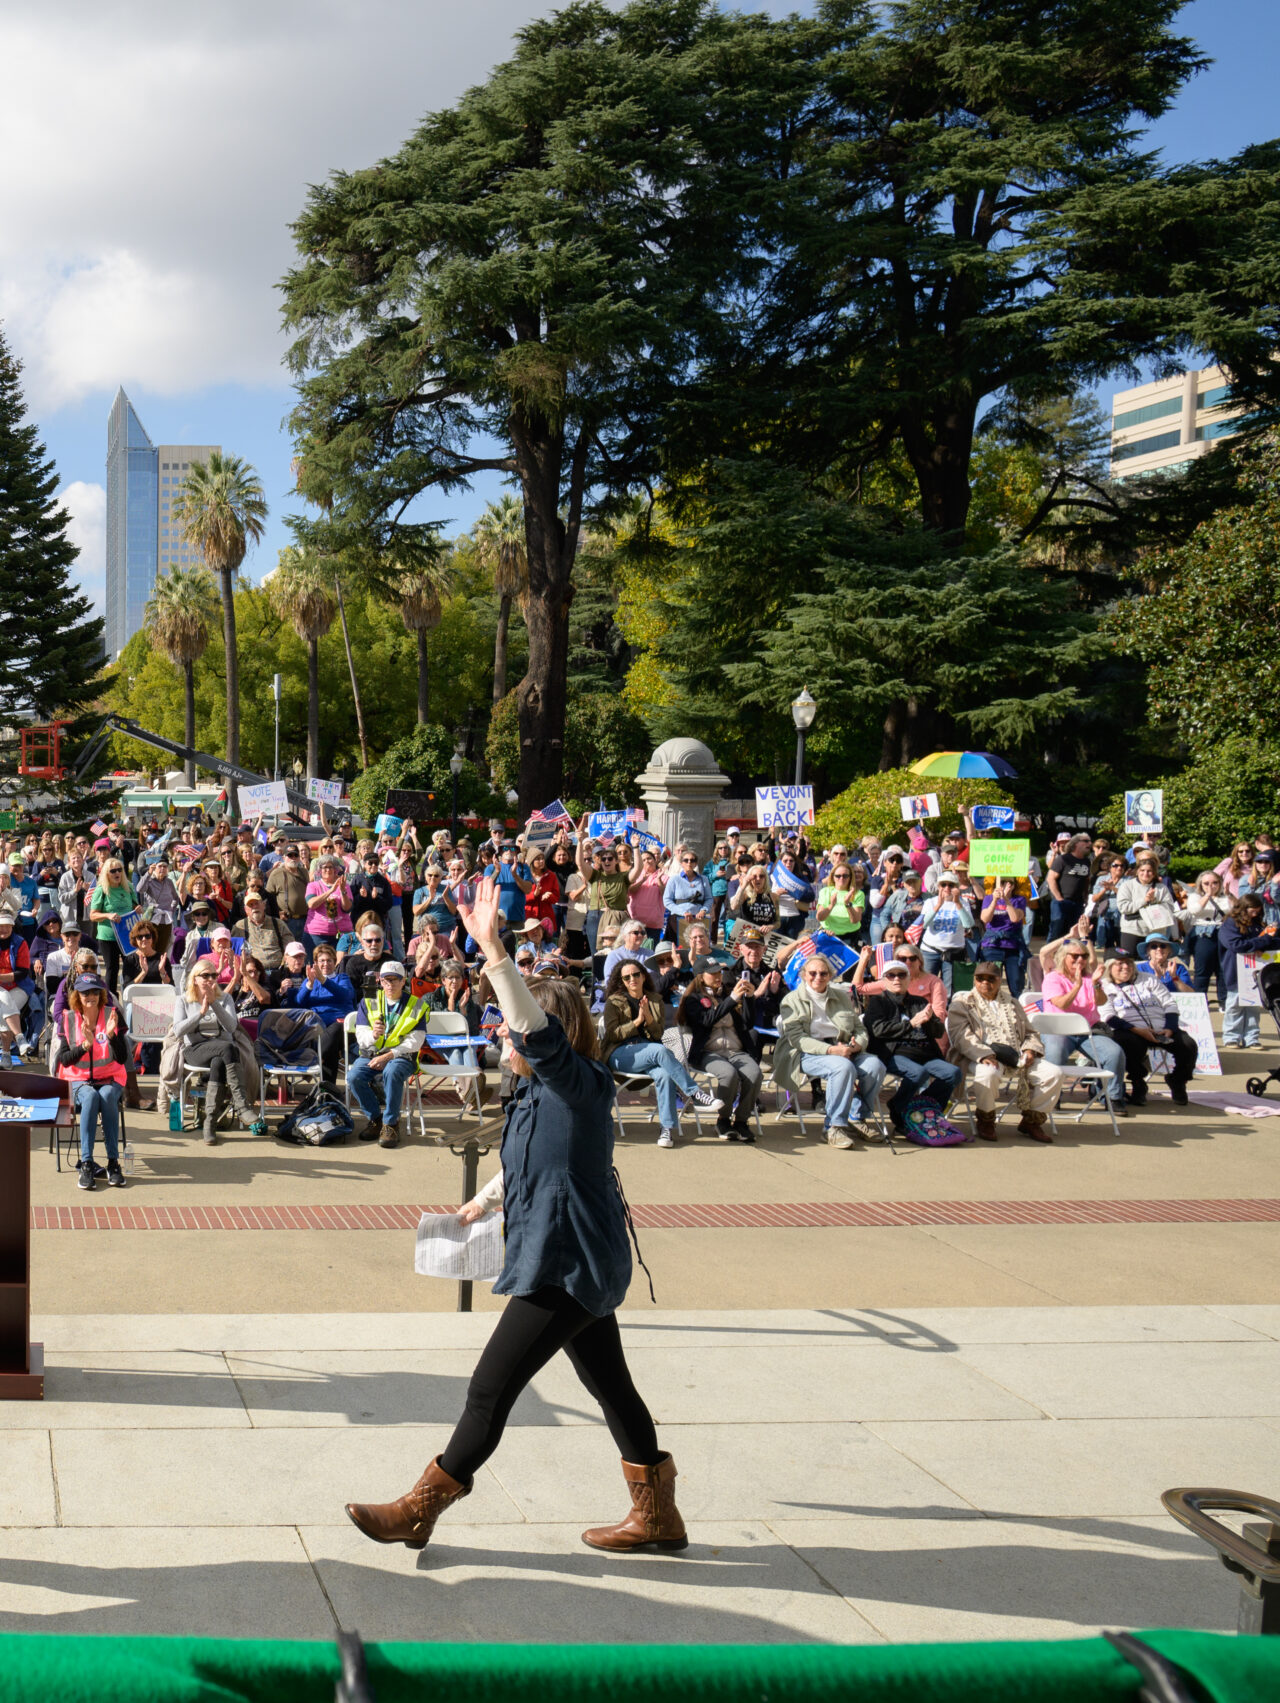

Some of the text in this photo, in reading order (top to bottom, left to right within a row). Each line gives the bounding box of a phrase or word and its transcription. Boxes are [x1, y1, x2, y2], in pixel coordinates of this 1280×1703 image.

[248, 785, 272, 797] VOTE
[756, 786, 812, 800] WE WONT
[776, 800, 797, 811] GO
[763, 809, 813, 827] BACK!
[983, 854, 1016, 863] GOING
[986, 864, 1014, 874] BACK
